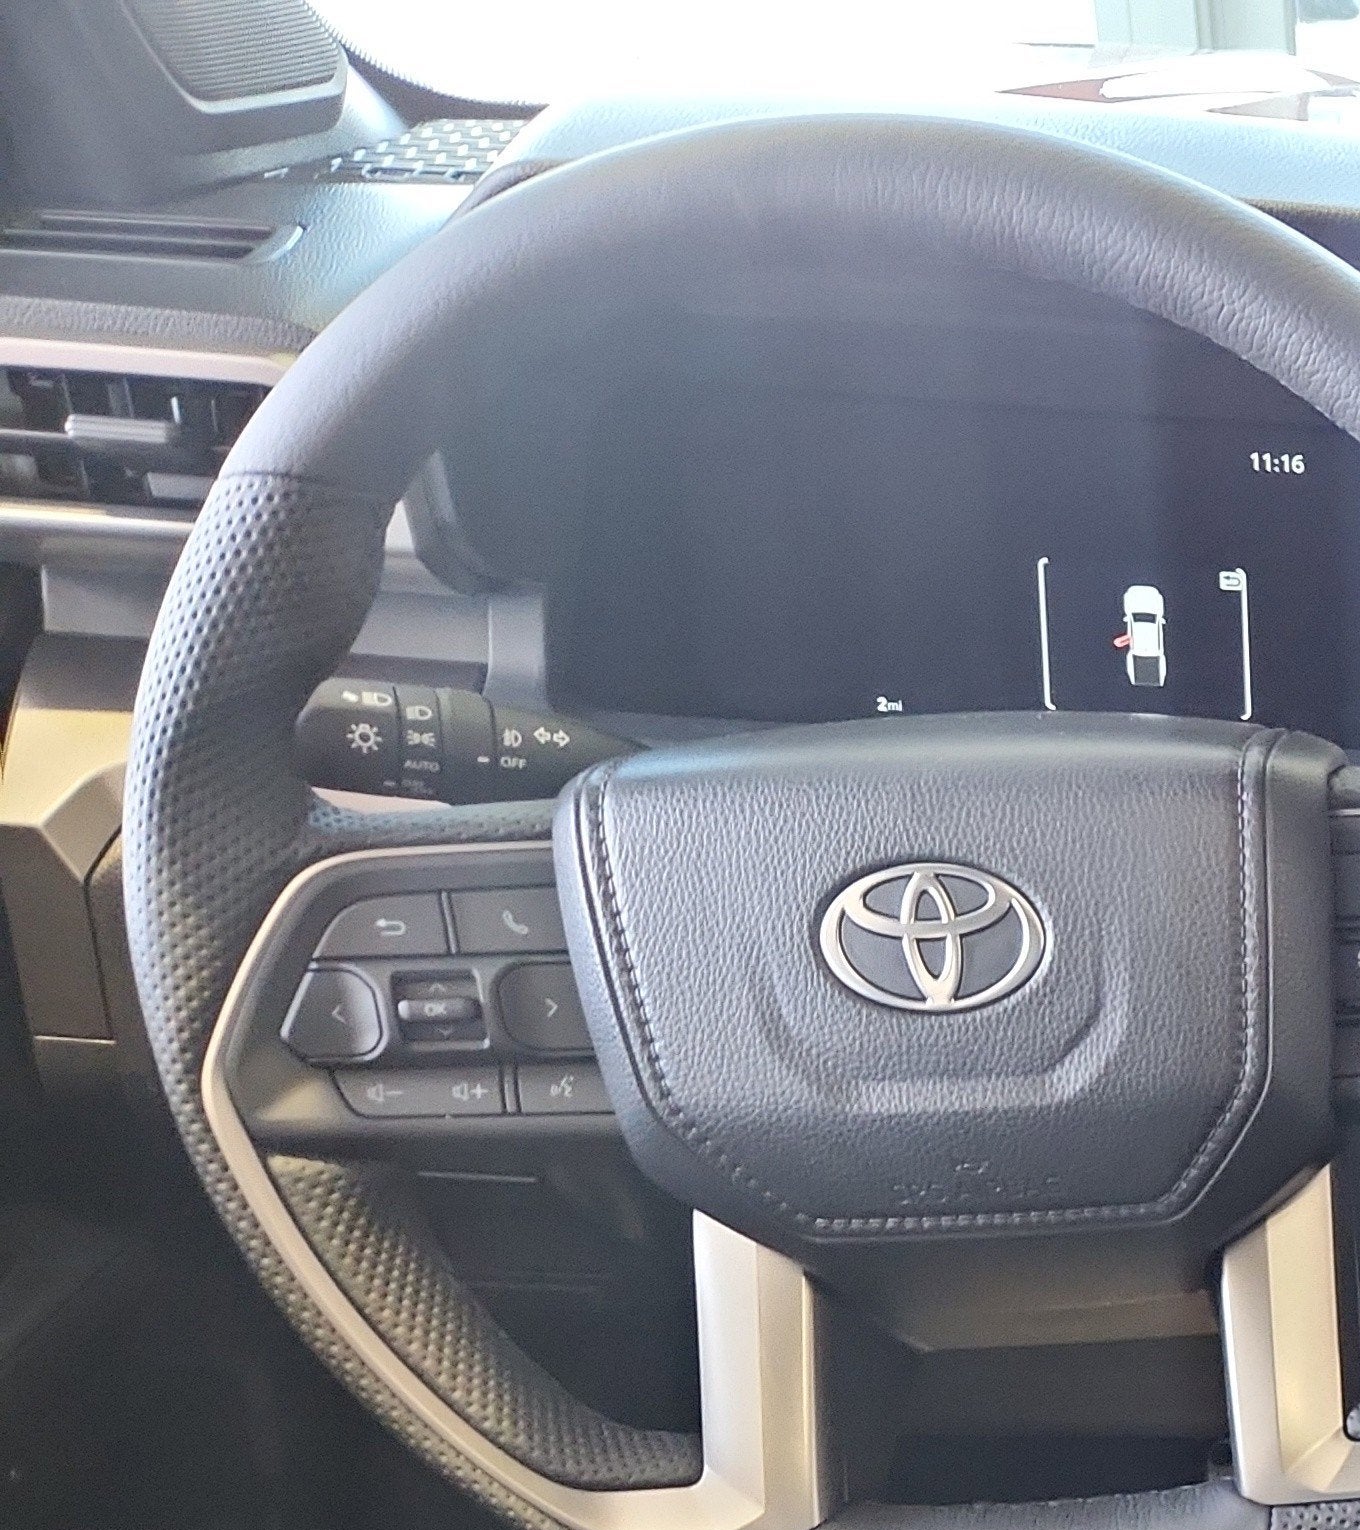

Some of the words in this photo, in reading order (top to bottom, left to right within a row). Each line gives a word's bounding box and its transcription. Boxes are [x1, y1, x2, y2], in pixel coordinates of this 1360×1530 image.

[1249, 452, 1306, 474] 11:16
[404, 758, 440, 772] AUTO
[501, 756, 527, 770] OFF
